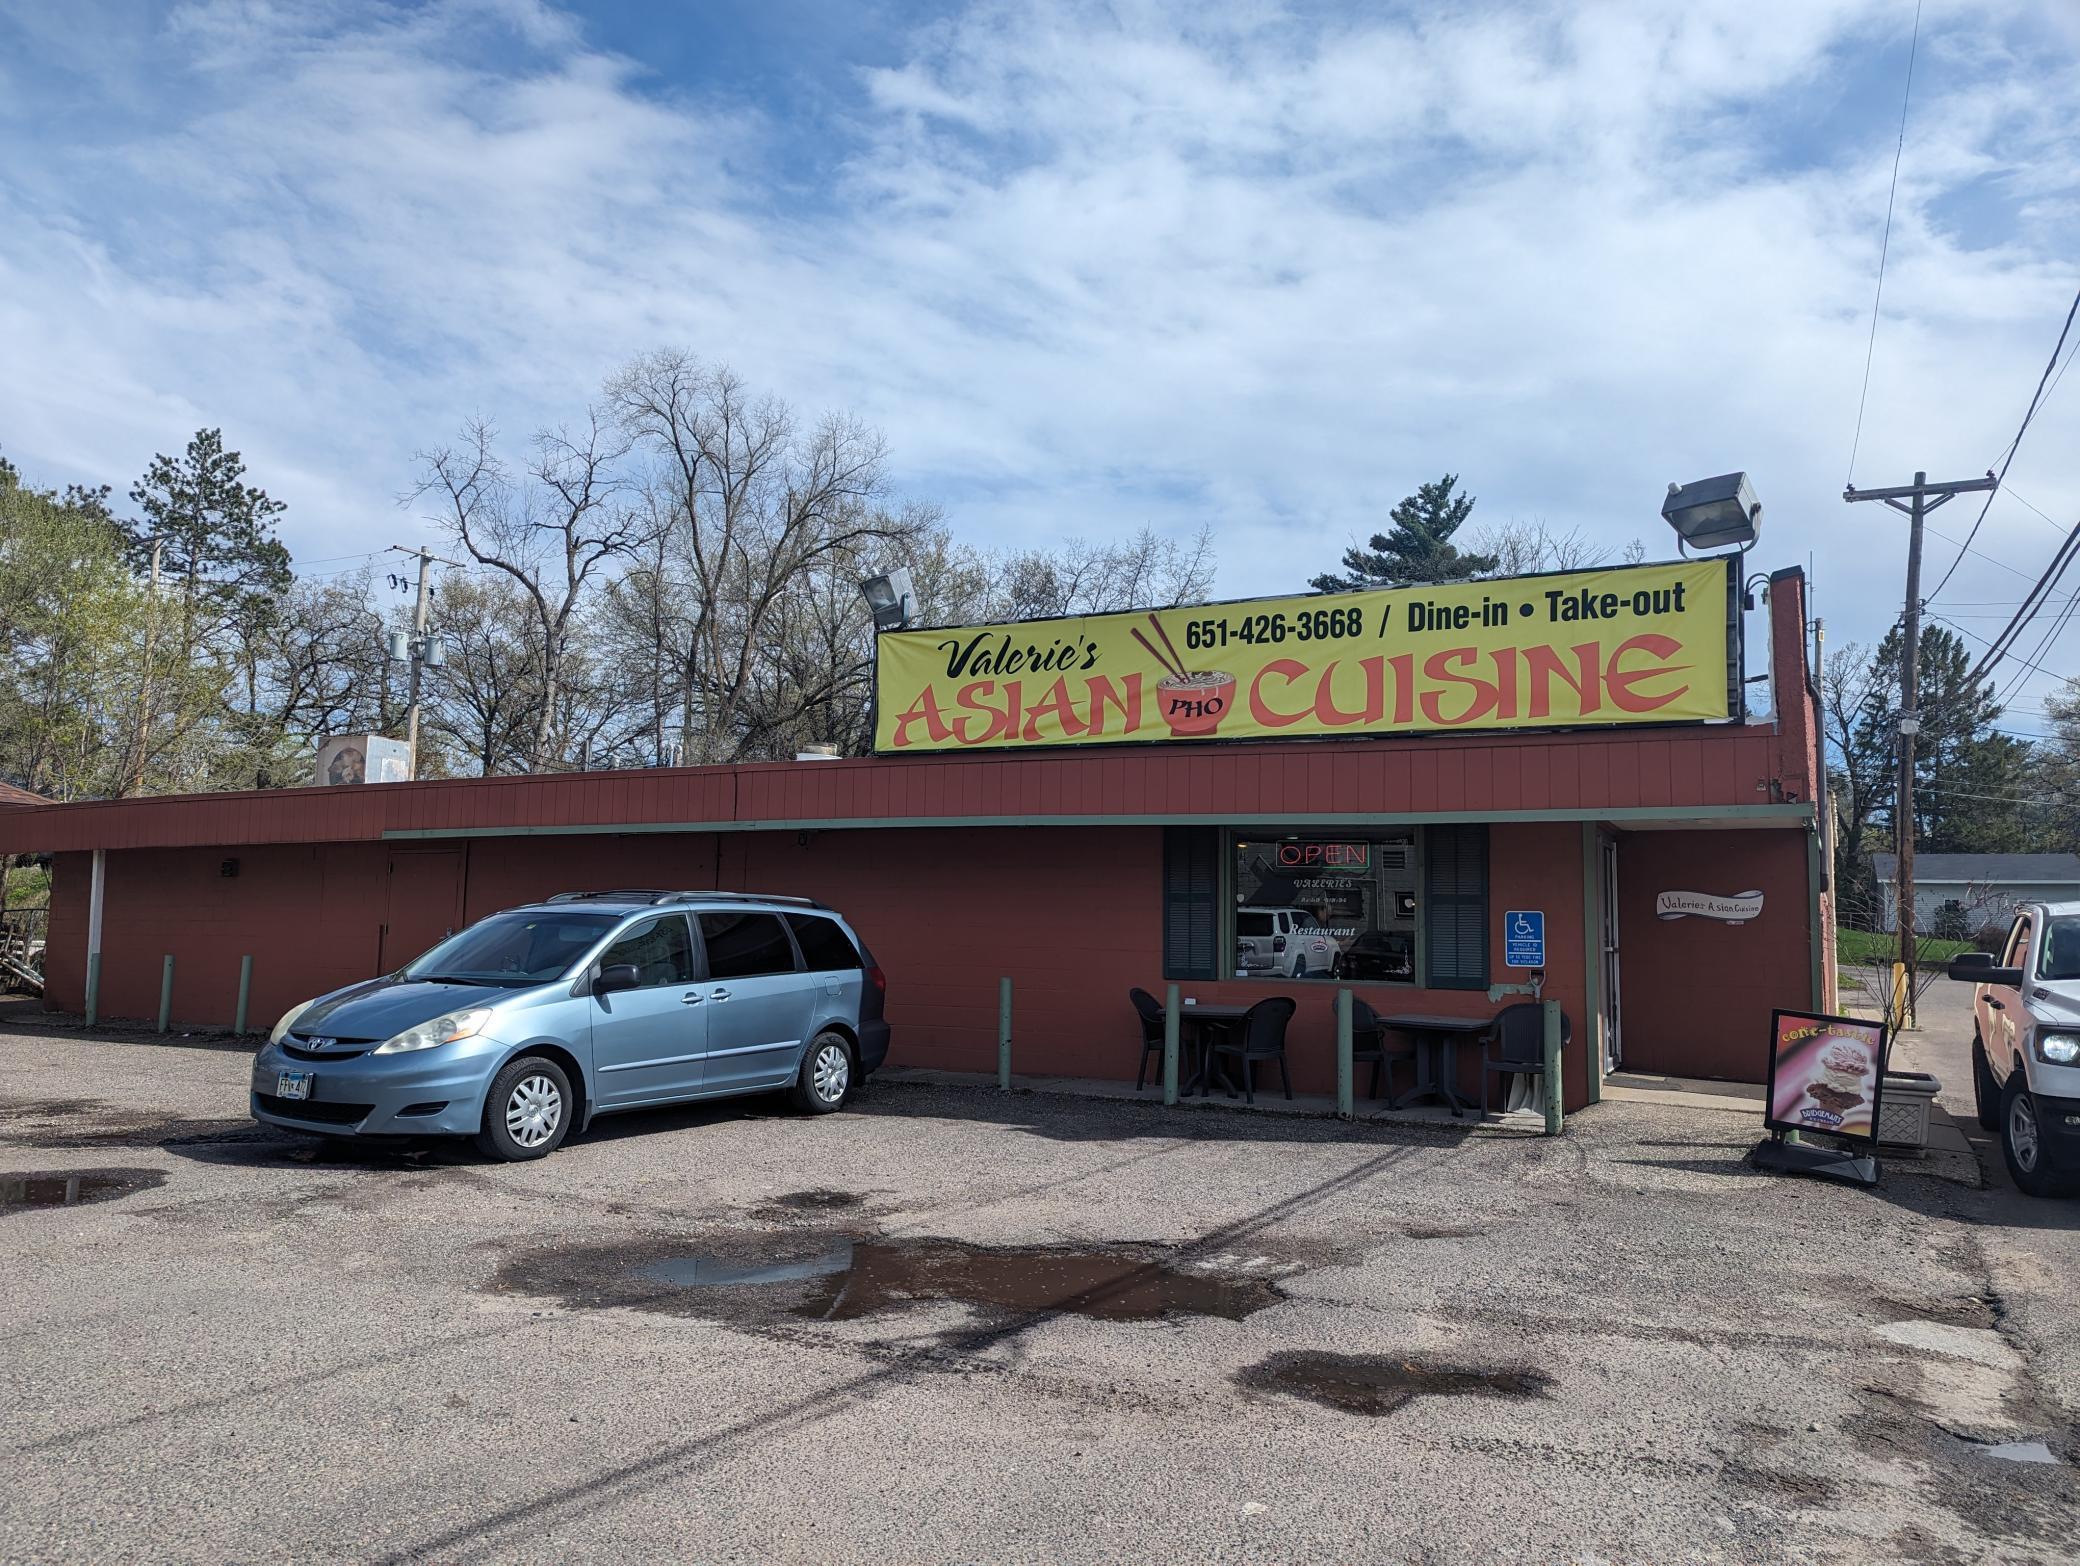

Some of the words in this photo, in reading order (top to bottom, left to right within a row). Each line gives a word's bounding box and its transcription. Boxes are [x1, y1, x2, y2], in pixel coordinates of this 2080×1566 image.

[1186, 607, 1363, 650] 651-426-3668
[1408, 596, 1508, 632] Dine-in
[1544, 581, 1686, 623] Take-out
[937, 632, 1101, 679] Valerie's
[893, 672, 1143, 748] ASIAN
[1250, 633, 1695, 727] CUISINE
[1169, 697, 1224, 717] PHO
[1280, 845, 1366, 864] OPEN
[1293, 879, 1353, 889] VALERIES
[1289, 923, 1356, 937] Restaurant
